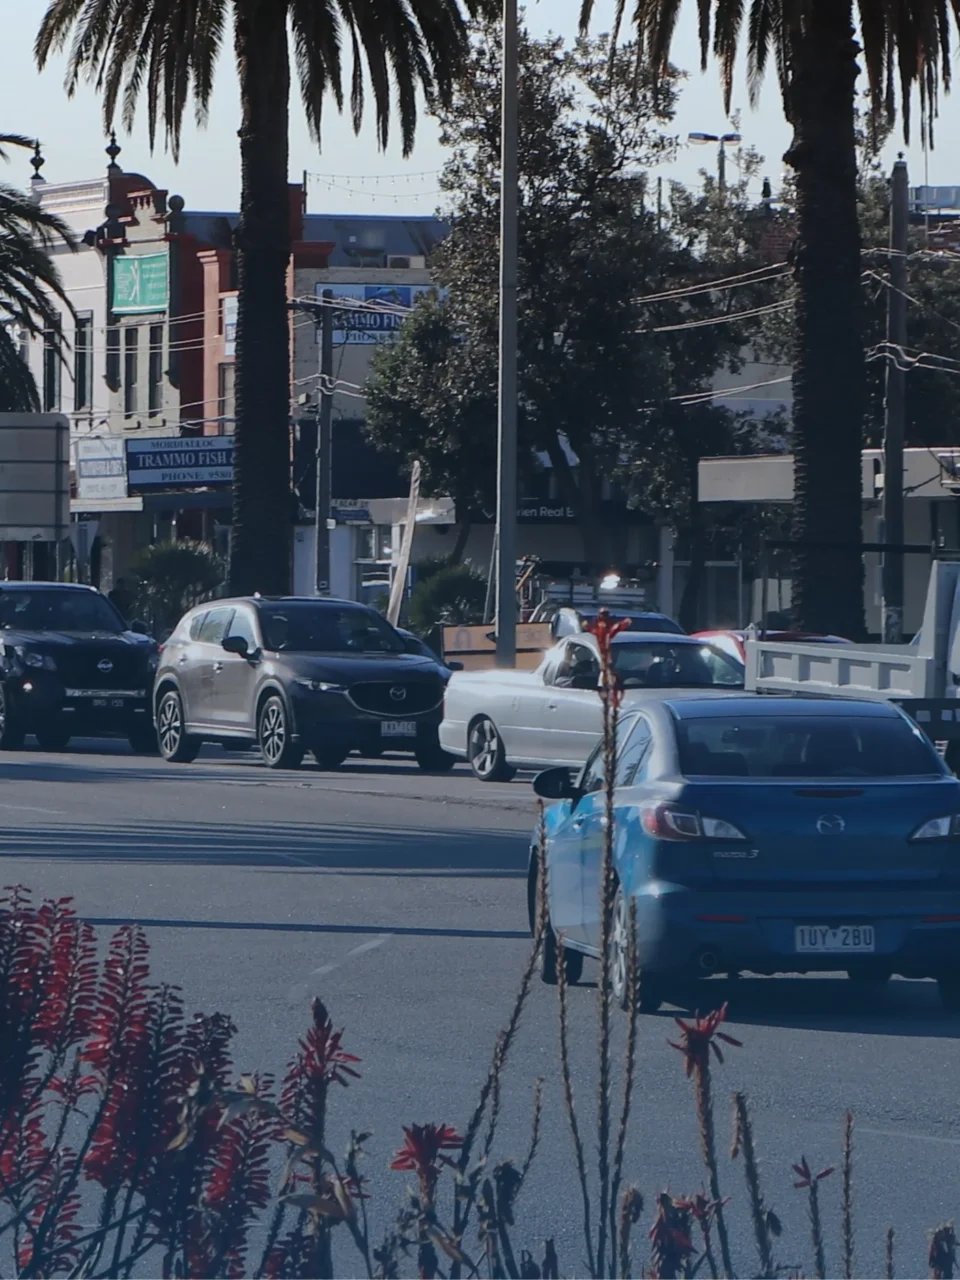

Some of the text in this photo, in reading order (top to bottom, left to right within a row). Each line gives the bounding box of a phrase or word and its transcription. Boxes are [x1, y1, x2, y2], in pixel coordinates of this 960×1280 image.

[150, 439, 217, 449] MORDIALLOC
[136, 452, 196, 468] TRAMMO
[198, 451, 227, 465] FISH
[539, 506, 564, 517] Real
[799, 928, 872, 946] 1UY 2BU
